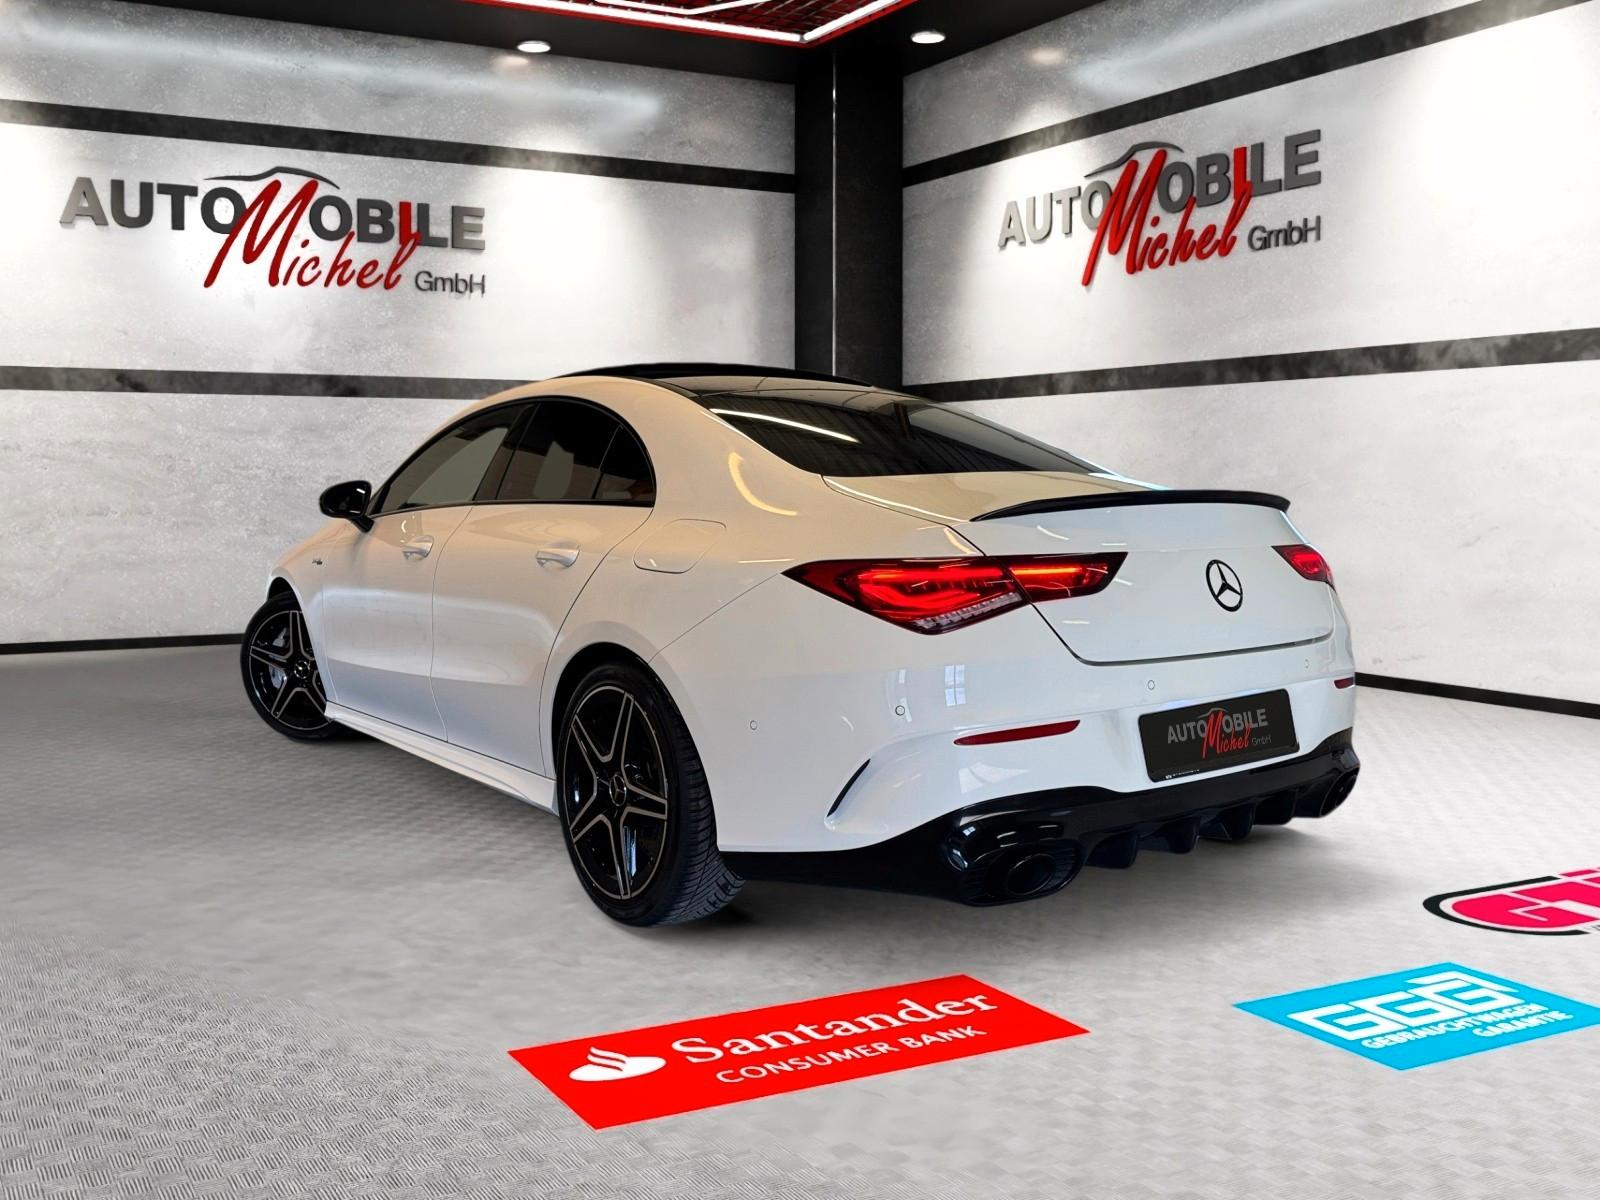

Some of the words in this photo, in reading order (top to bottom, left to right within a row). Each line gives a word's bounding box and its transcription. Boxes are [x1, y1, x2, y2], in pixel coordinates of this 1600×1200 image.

[203, 179, 422, 290] Michel
[414, 270, 487, 298] GmbH
[1081, 148, 1254, 287] Michel
[1248, 215, 1322, 252] GmbH
[1202, 709, 1254, 759] Michel
[1251, 735, 1272, 747] GmbH
[671, 993, 998, 1064] Santander
[716, 1039, 898, 1085] CONSUMER
[902, 1024, 988, 1050] BANK
[1360, 1002, 1550, 1050] GEBRAUCHTWAGEN
[1472, 1010, 1574, 1038] GARANTIE
